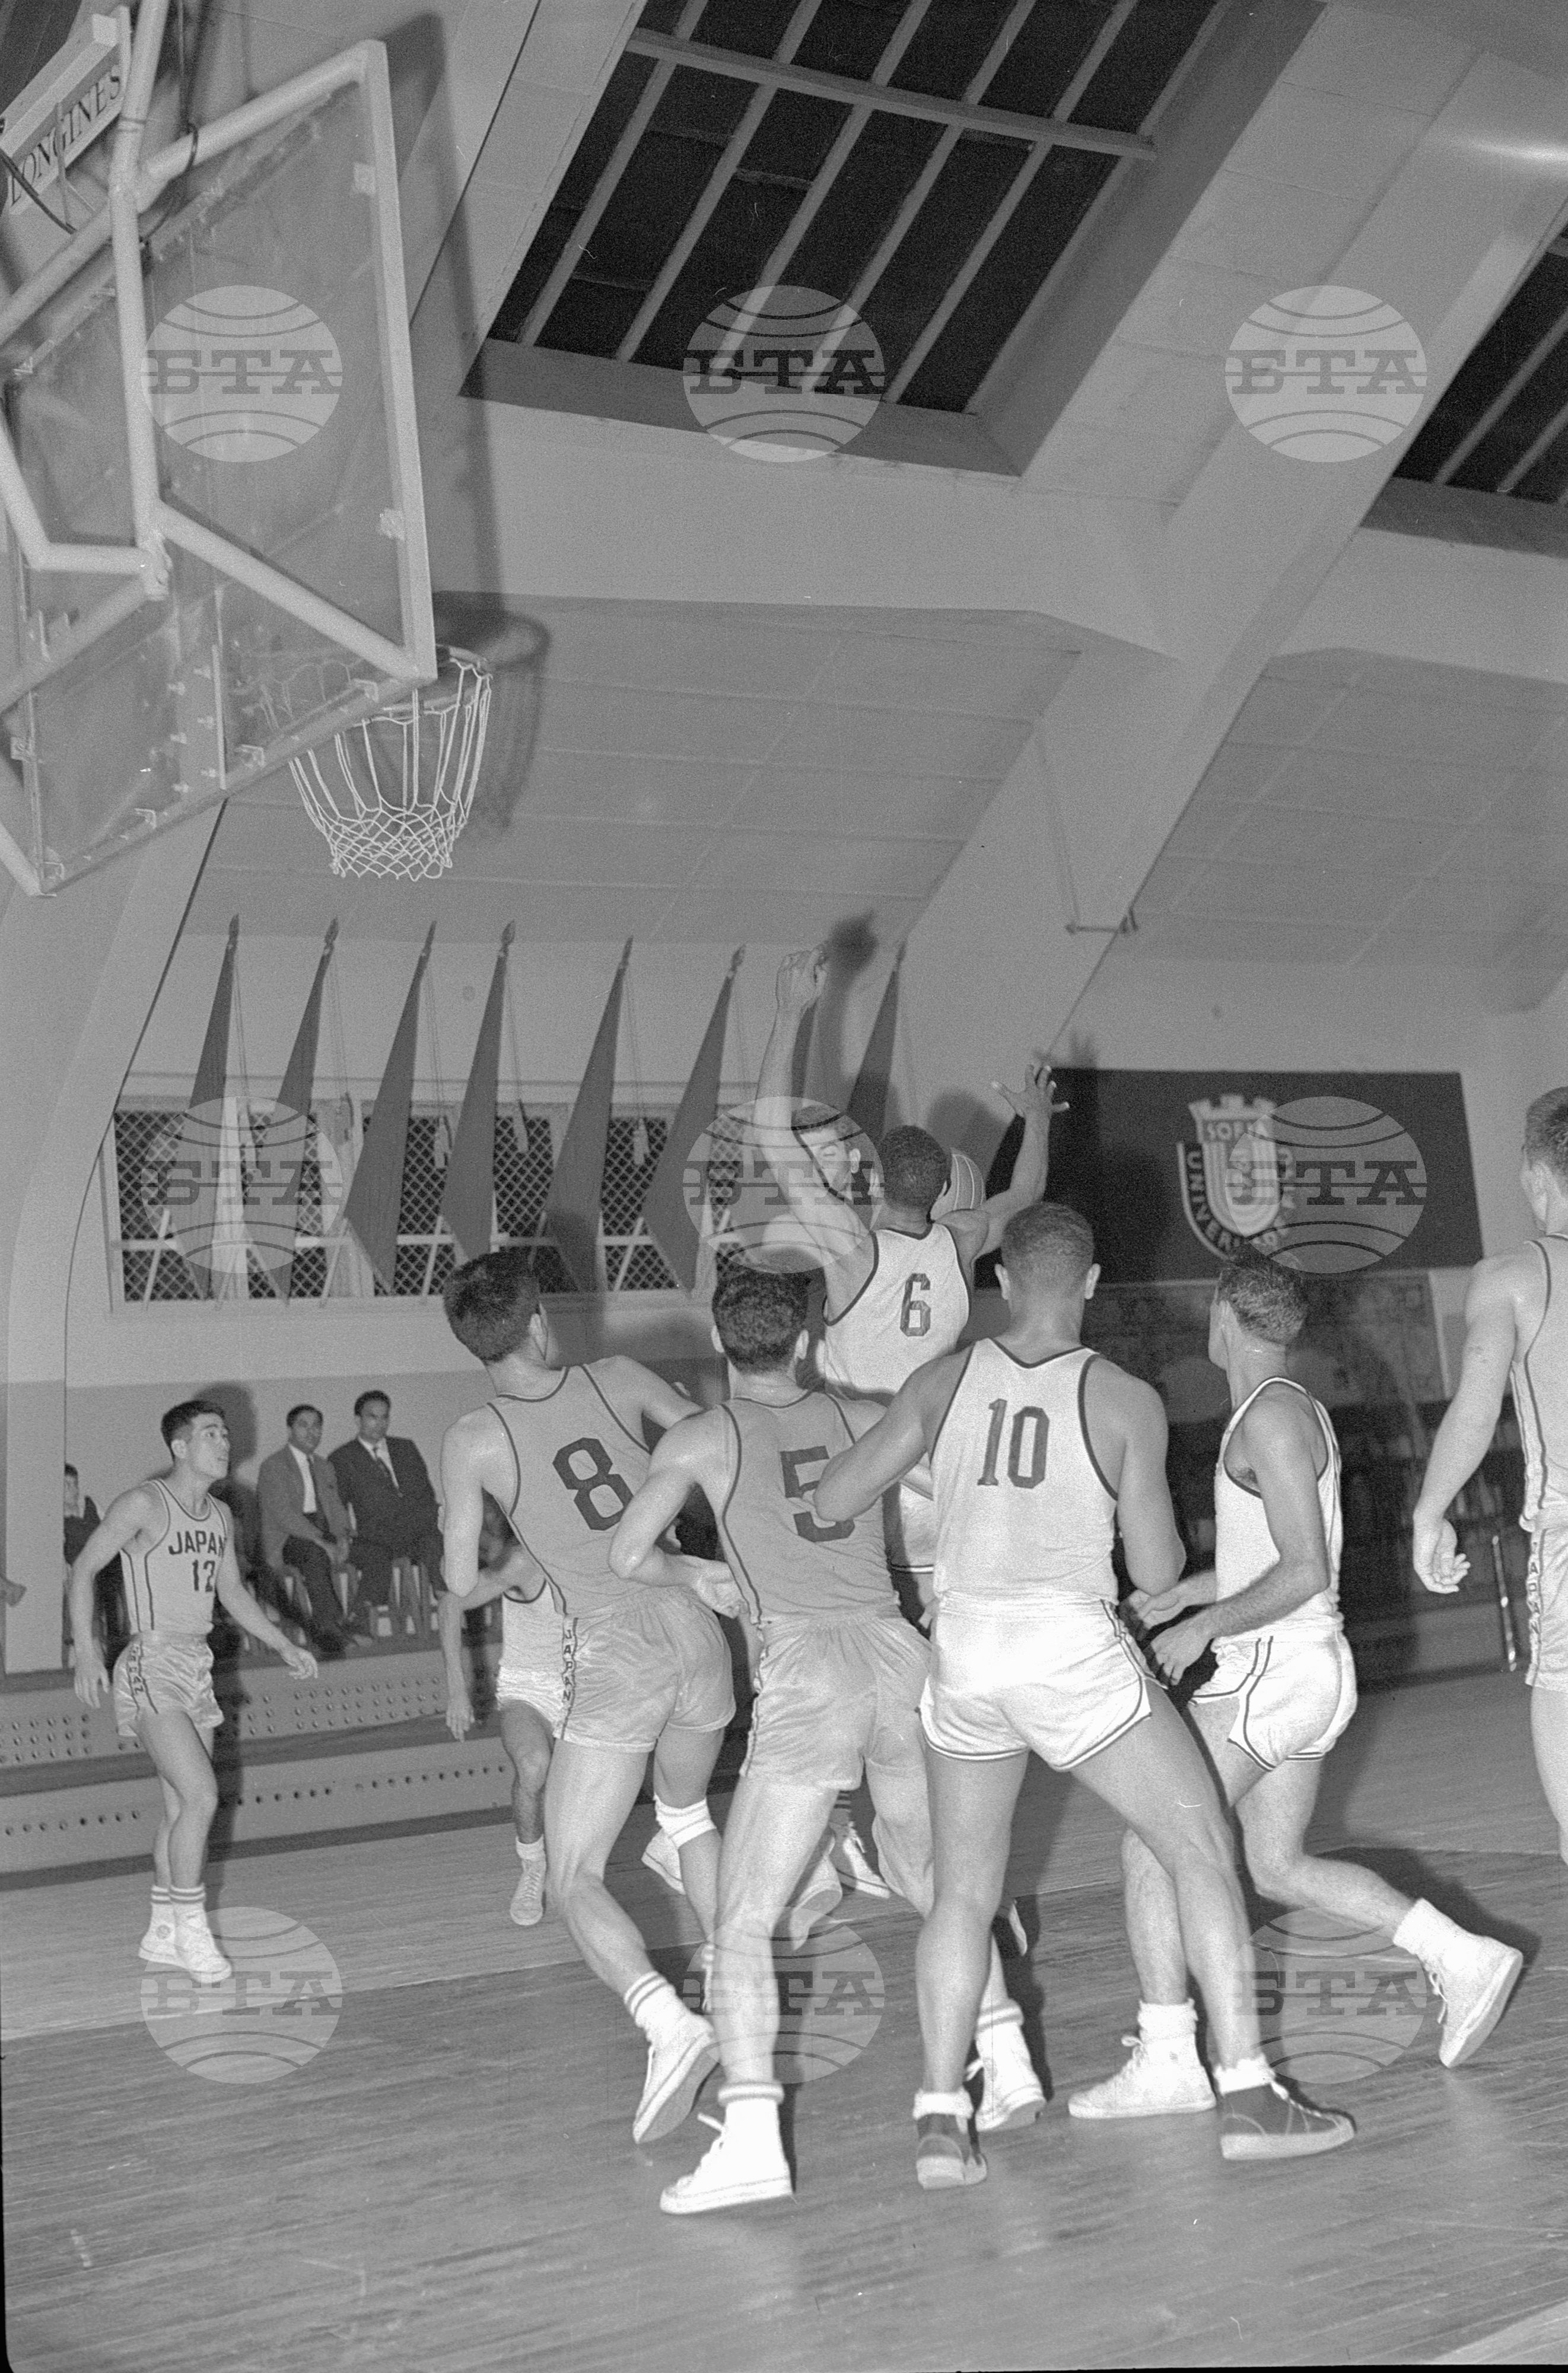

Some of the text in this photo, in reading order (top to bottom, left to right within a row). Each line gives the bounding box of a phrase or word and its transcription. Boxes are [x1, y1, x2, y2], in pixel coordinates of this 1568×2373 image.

[10, 75, 120, 206] LONGINES
[900, 1273, 931, 1336] 6
[552, 1437, 634, 1531] 8
[977, 1398, 1049, 1489] 10
[780, 1446, 855, 1542] 5
[168, 1531, 224, 1557] JAPAN
[564, 1629, 574, 1701] JAPAN
